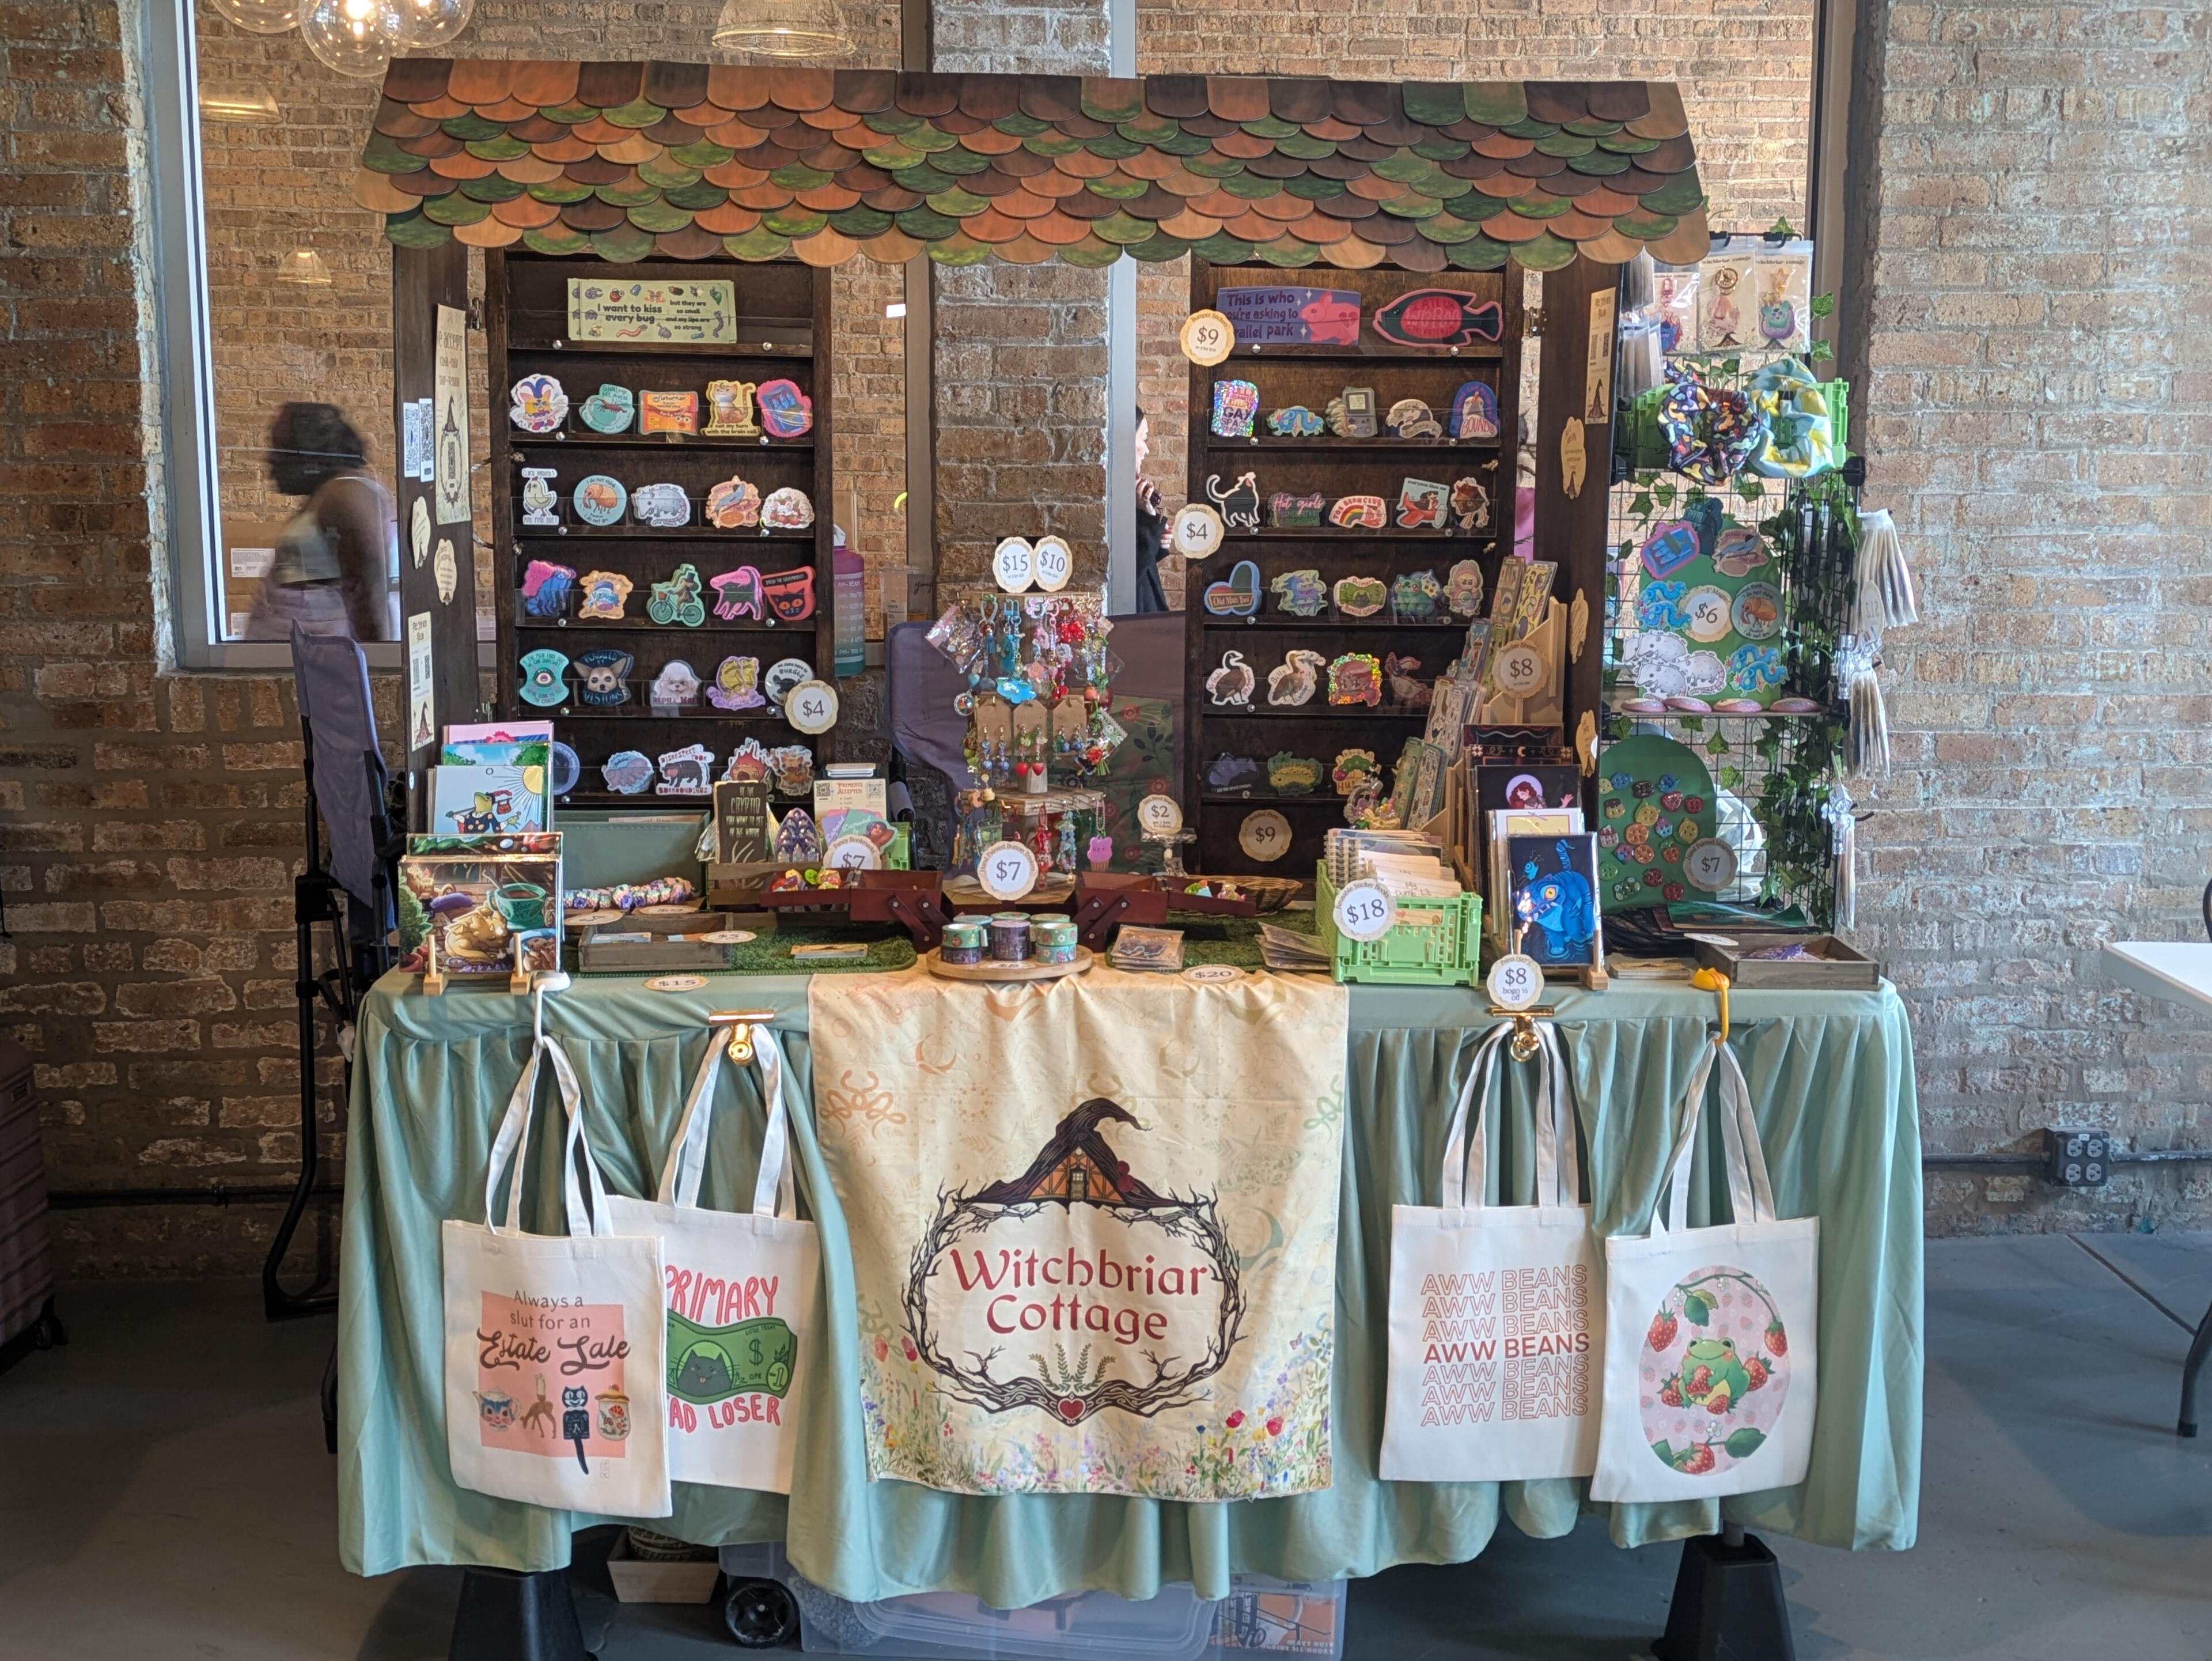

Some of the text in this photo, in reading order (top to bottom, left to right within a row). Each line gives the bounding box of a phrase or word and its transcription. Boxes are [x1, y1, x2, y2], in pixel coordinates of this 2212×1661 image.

[597, 304, 662, 313] I want to kiss
[1228, 291, 1295, 307] This is who
[605, 315, 655, 324] every bug
[1253, 307, 1298, 323] asking to
[1197, 325, 1219, 345] $9
[1267, 322, 1294, 339] park
[1275, 494, 1324, 516] Hot girls
[1187, 521, 1209, 541] $4
[1002, 554, 1028, 574] $15
[1040, 549, 1066, 572] $10
[1695, 601, 1718, 624] $6
[584, 651, 618, 664] PLAGUED
[779, 668, 805, 679] BURGLE
[1510, 658, 1533, 680] $8
[583, 691, 623, 704] VISIONS
[802, 699, 825, 718] $4
[730, 797, 761, 814] CRYPTID
[1151, 804, 1170, 819] $2
[1255, 826, 1276, 844] $9
[841, 852, 865, 869] $7
[996, 859, 1021, 882] $7
[1701, 856, 1721, 873] $7
[1374, 883, 1390, 899] Books
[1346, 898, 1385, 926] $18
[1195, 969, 1232, 979] $20
[1505, 967, 1527, 987] $8
[949, 1247, 1208, 1296] Witchbriar
[1421, 1264, 1587, 1295] AWW BEANS
[514, 1290, 584, 1309] Always a
[665, 1265, 778, 1325] PRIMARY
[1422, 1286, 1588, 1318] AWW BEANS
[510, 1311, 590, 1330] slut for an
[986, 1292, 1168, 1345] Cottage
[1422, 1309, 1589, 1342] AWW BEANS
[476, 1326, 631, 1375] Estate Sale
[1423, 1333, 1590, 1364] AWW BEANS
[749, 1372, 762, 1380] OPE
[1422, 1354, 1589, 1386] AWW BEANS
[1421, 1373, 1589, 1406] AWW BEANS
[708, 1394, 781, 1429] LOSER
[1421, 1395, 1589, 1427] AWW BEANS
